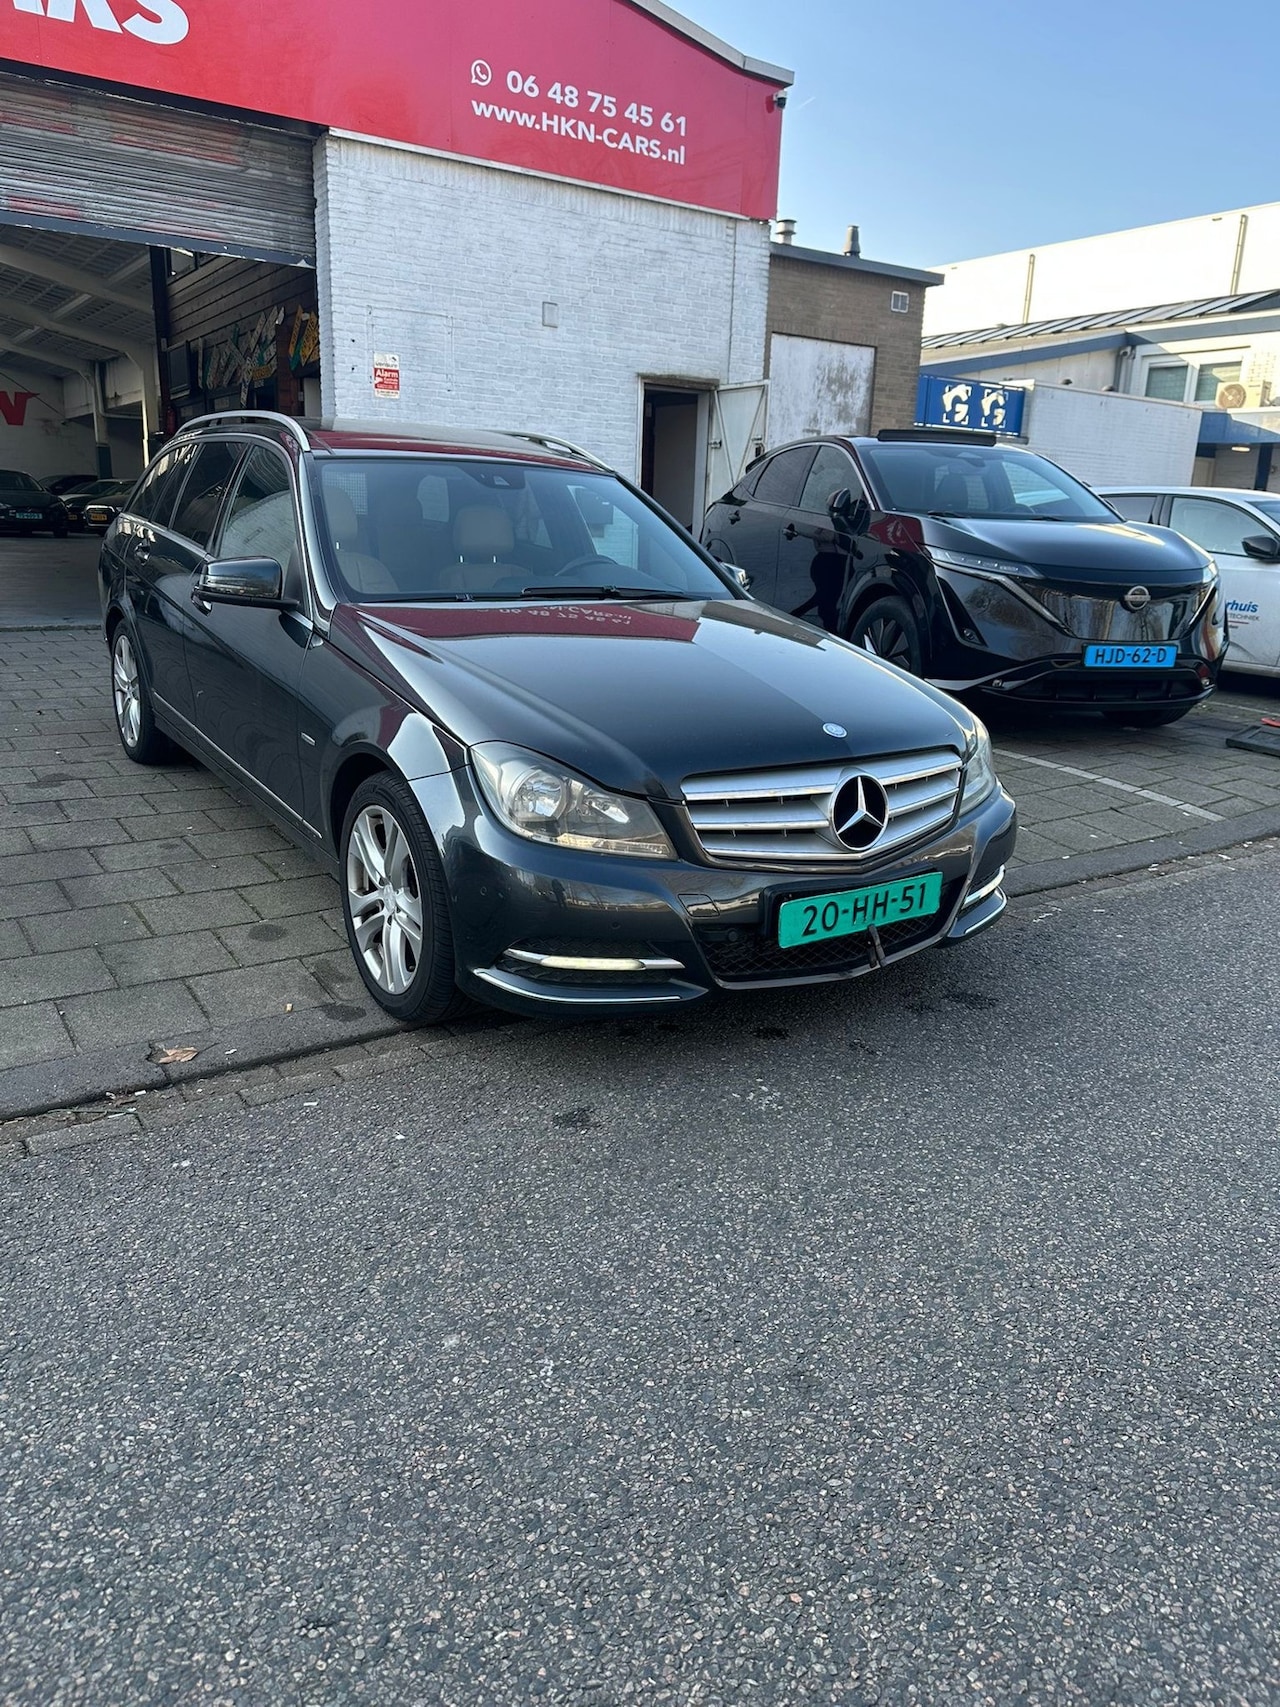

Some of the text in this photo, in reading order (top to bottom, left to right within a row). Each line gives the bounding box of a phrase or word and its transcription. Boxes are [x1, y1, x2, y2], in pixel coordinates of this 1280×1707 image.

[506, 70, 686, 137] 06 48 75 45 61
[471, 100, 685, 165] www.HKN-CARS.nl
[375, 369, 398, 378] Alarm
[1095, 648, 1167, 664] HJD-62-D
[802, 882, 926, 937] 20-HH-51
